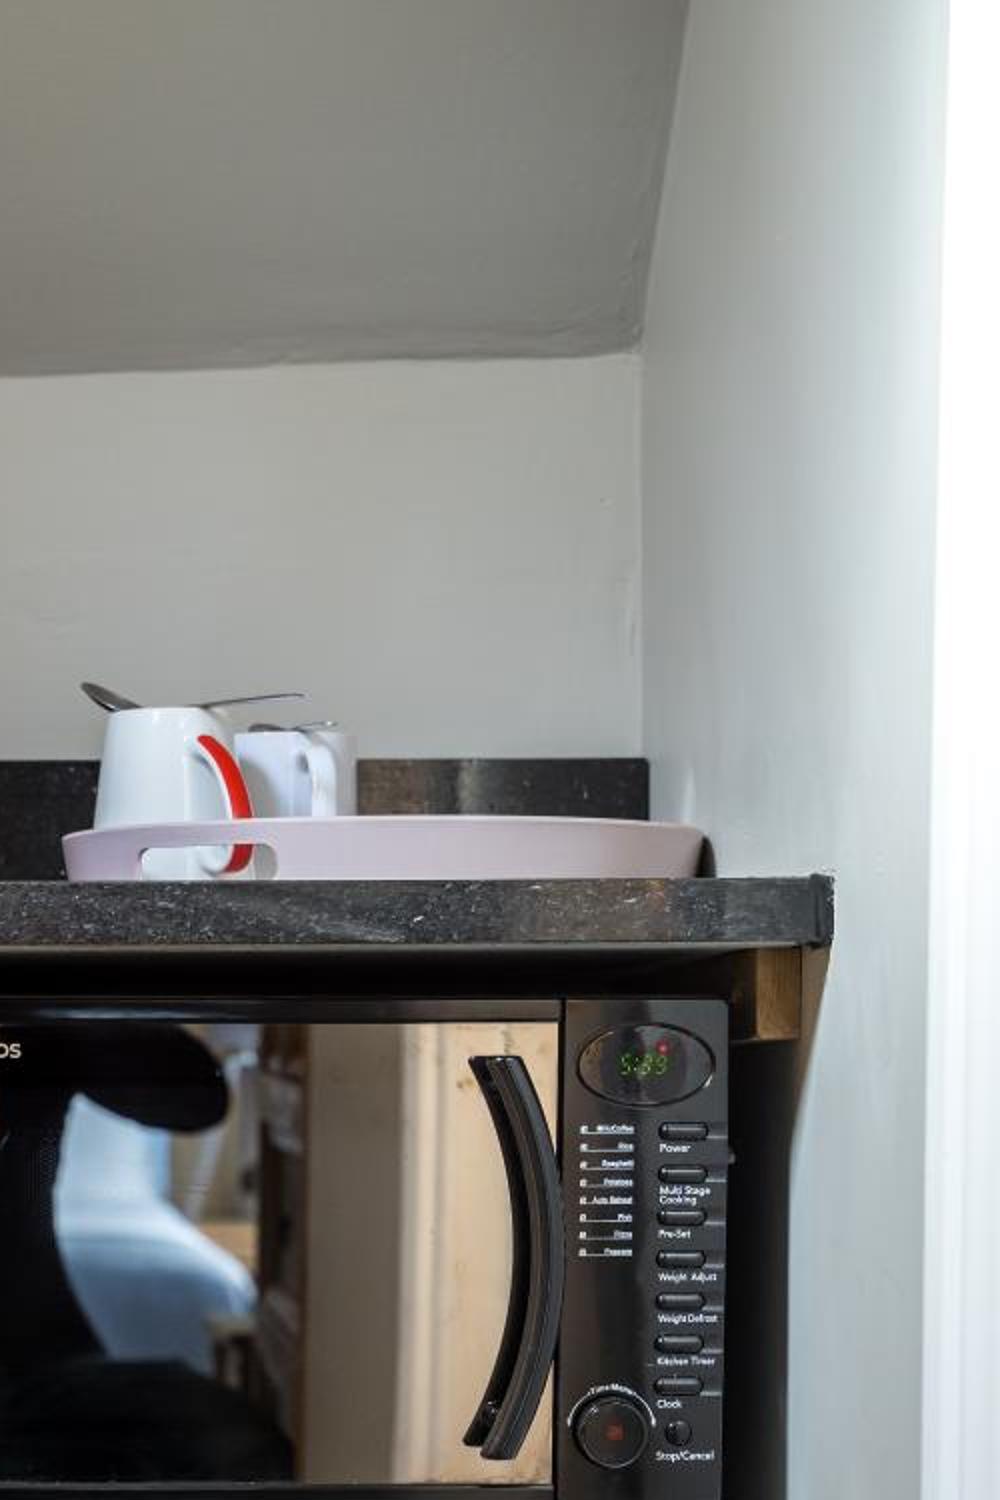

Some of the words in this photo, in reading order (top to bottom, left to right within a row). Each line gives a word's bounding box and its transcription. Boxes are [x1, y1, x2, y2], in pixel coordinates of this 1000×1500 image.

[659, 1143, 691, 1153] Power
[657, 1272, 687, 1284] Weight
[691, 1272, 717, 1284] Adjust
[657, 1313, 687, 1325] Weight
[657, 1399, 682, 1409] Clock
